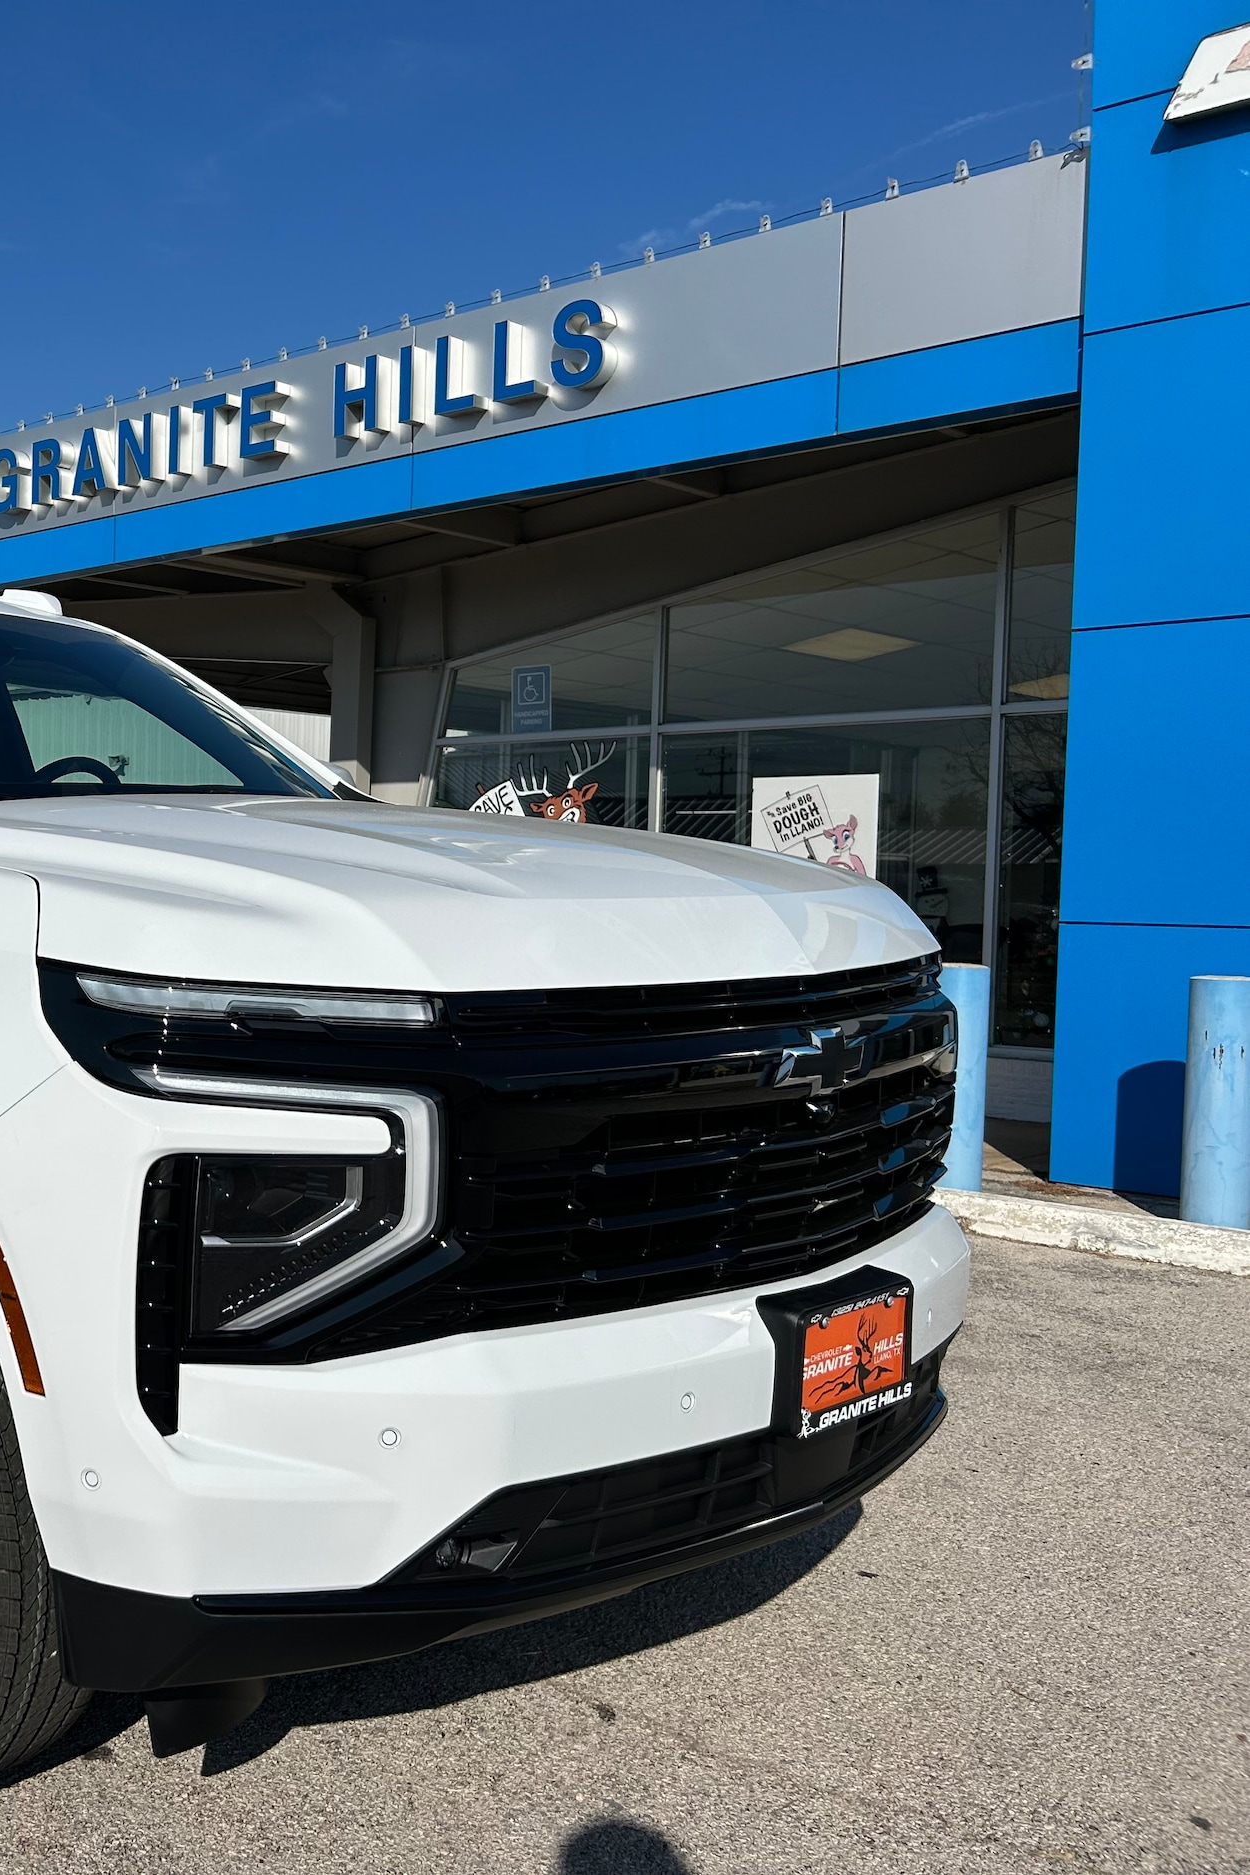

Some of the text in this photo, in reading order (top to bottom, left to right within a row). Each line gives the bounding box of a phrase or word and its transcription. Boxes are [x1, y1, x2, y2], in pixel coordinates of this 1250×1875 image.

[333, 299, 617, 440] HILLS
[773, 802, 820, 834] DOUGH
[776, 802, 797, 816] Save
[789, 816, 824, 838] LLANO!
[810, 1346, 843, 1363] CHEVROLET
[873, 1332, 904, 1356] HILLS
[893, 1347, 902, 1356] TX
[819, 1382, 912, 1428] GRANITE HILLS
